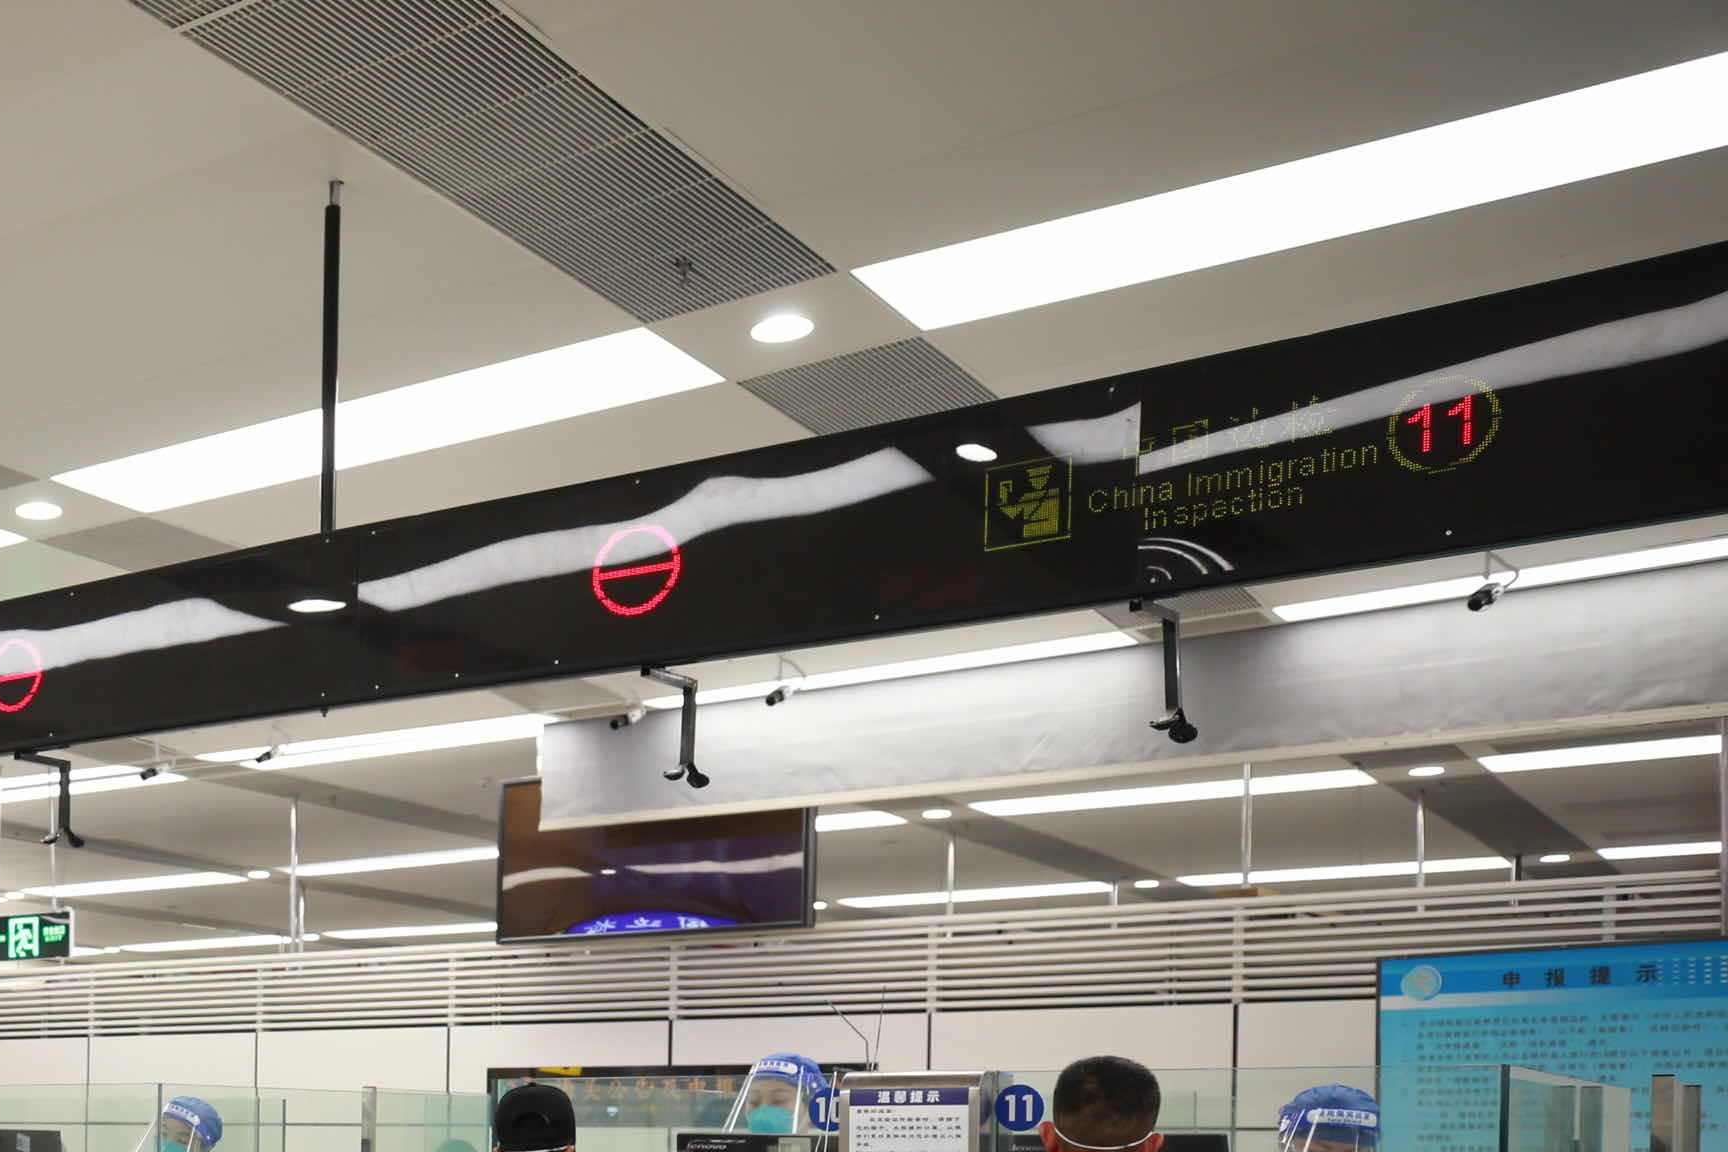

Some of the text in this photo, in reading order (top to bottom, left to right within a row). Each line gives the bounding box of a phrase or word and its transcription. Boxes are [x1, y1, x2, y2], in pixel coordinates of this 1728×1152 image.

[1406, 394, 1473, 453] 11
[1088, 442, 1378, 514] China Immigration
[1143, 486, 1304, 530] Inspection
[877, 1090, 940, 1104] 温馨提示
[1005, 1094, 1034, 1122] 11
